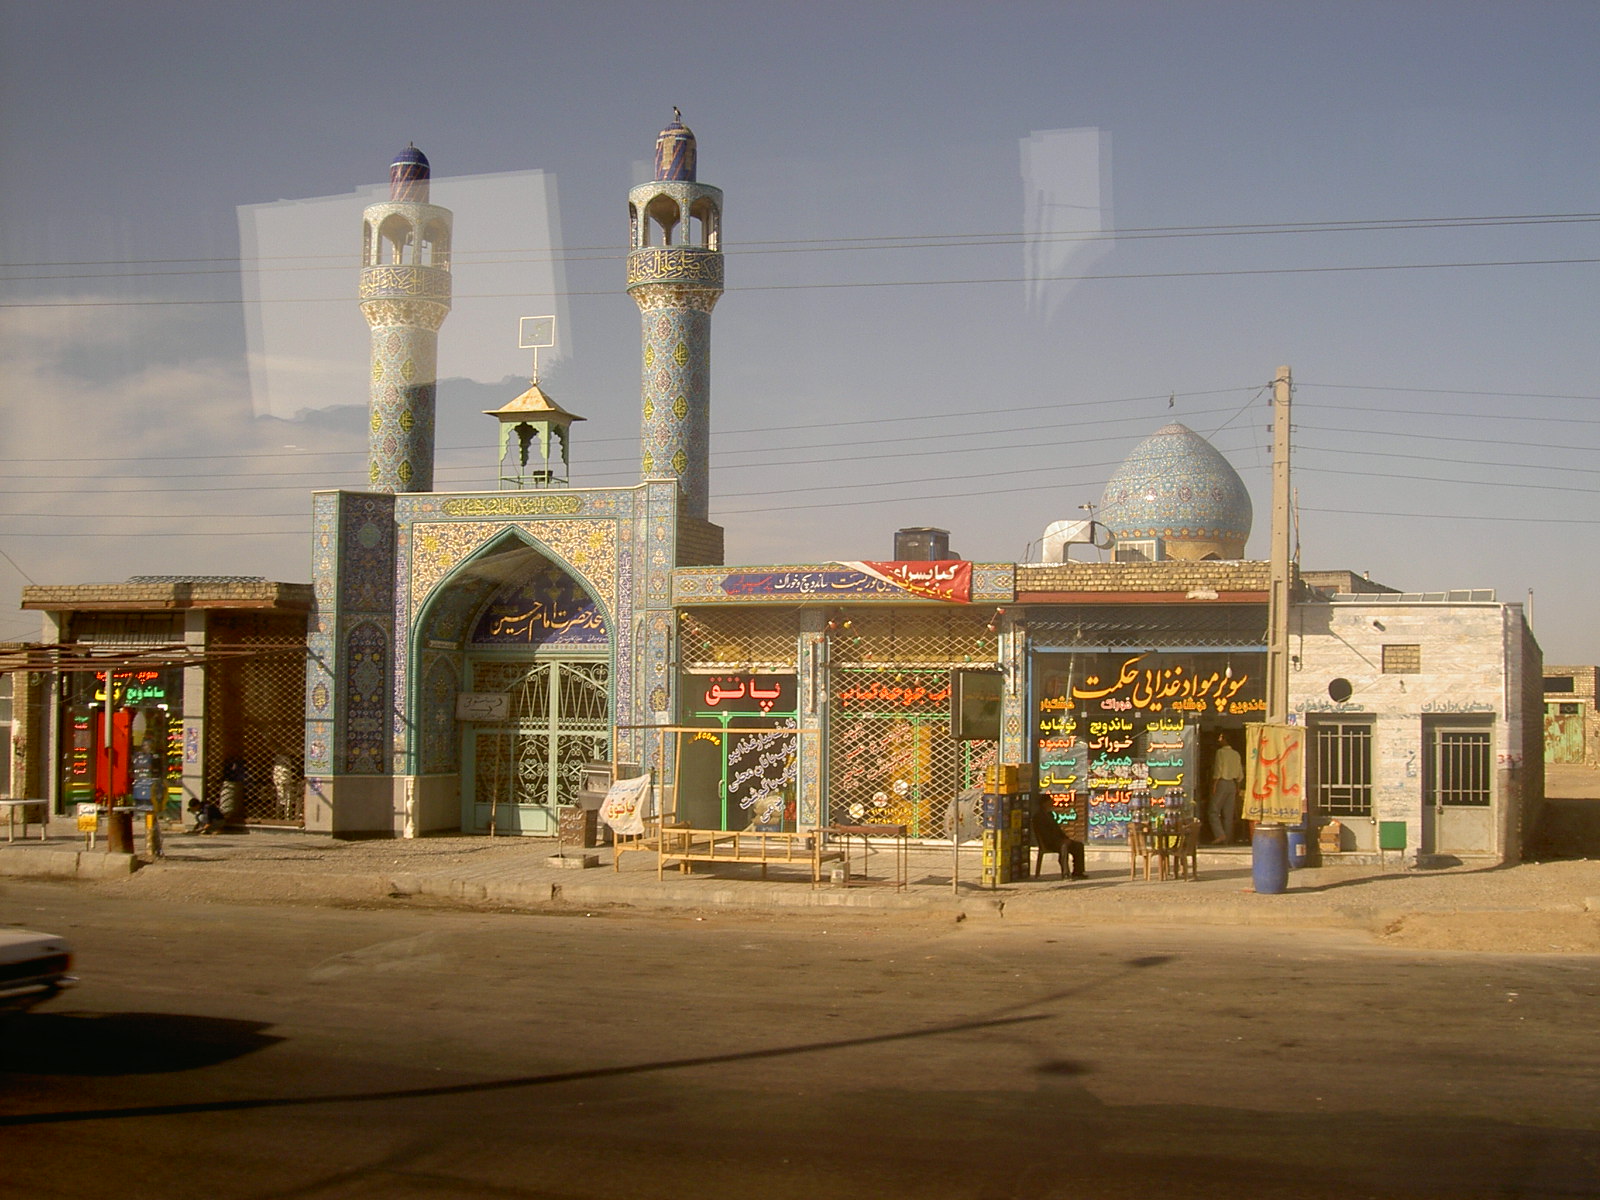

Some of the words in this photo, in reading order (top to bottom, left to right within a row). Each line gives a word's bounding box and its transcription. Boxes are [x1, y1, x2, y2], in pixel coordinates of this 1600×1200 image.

[489, 600, 543, 636] حسین
[1072, 651, 1151, 699] حکمت
[1183, 671, 1220, 697] مواد
[125, 685, 165, 704] ساندویچ
[1132, 665, 1183, 711] غذایی
[1213, 673, 1247, 712] سوپر
[1100, 695, 1133, 712] خوراک
[1171, 696, 1207, 714] نوشابه
[1039, 717, 1077, 736] نوشابه
[1089, 717, 1133, 736] ساندویچ
[1146, 718, 1184, 736] لبنیات
[1039, 736, 1077, 753] آبمیوه
[1089, 736, 1133, 753] خوراک
[1147, 737, 1184, 752] شیر
[1039, 754, 1077, 770] بستنی
[1090, 752, 1133, 770] همبرگر
[1146, 754, 1184, 767] ماست
[1039, 772, 1078, 788] چای
[1146, 773, 1184, 789] کره
[1252, 766, 1300, 800] ماهی
[1089, 790, 1133, 807] کالباس
